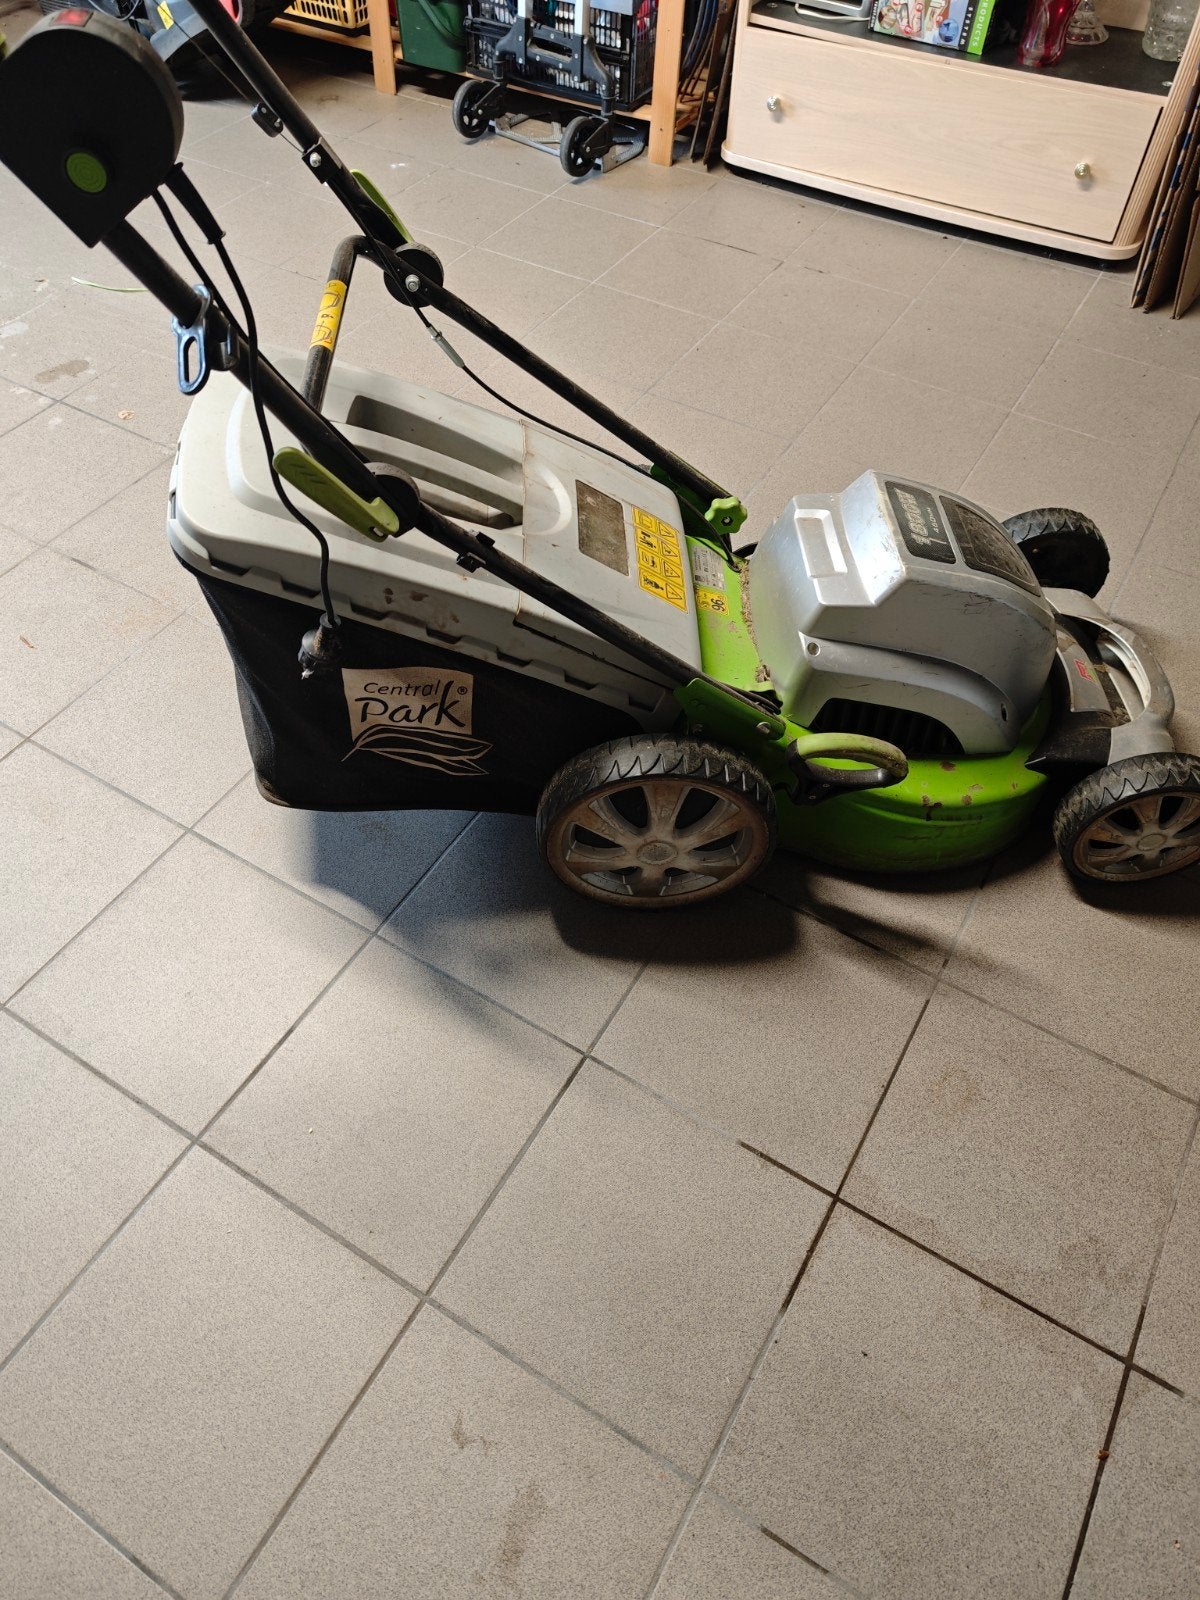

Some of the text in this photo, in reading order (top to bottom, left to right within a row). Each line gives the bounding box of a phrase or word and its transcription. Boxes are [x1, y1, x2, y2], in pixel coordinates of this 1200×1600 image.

[972, 0, 988, 46] RODUCTS
[711, 598, 725, 611] 96
[354, 680, 466, 727] Park
[363, 680, 441, 697] Central
